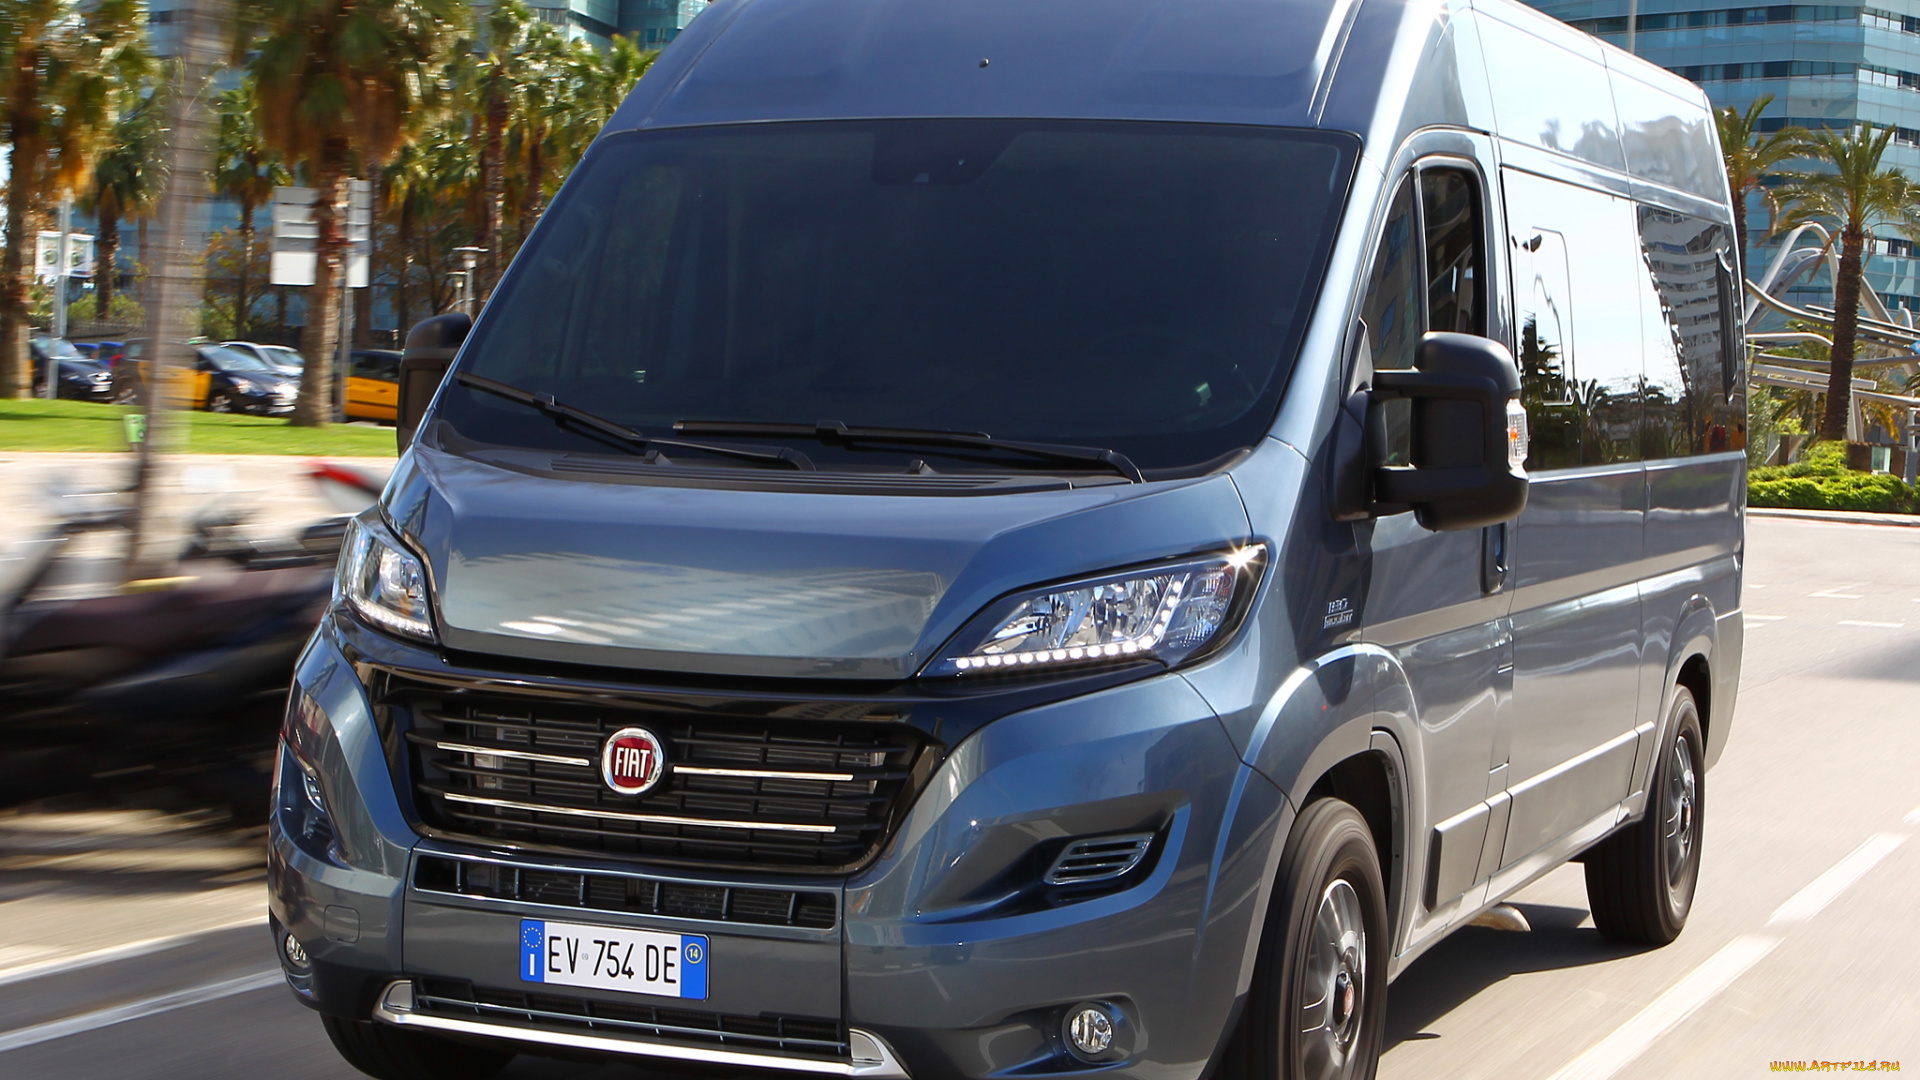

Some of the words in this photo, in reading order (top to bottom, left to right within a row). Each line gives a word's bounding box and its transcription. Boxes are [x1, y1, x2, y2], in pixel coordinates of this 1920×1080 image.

[614, 747, 651, 779] FIAT
[548, 935, 579, 974] EV
[593, 940, 635, 980] 754
[645, 944, 677, 984] DE
[688, 948, 699, 958] 14
